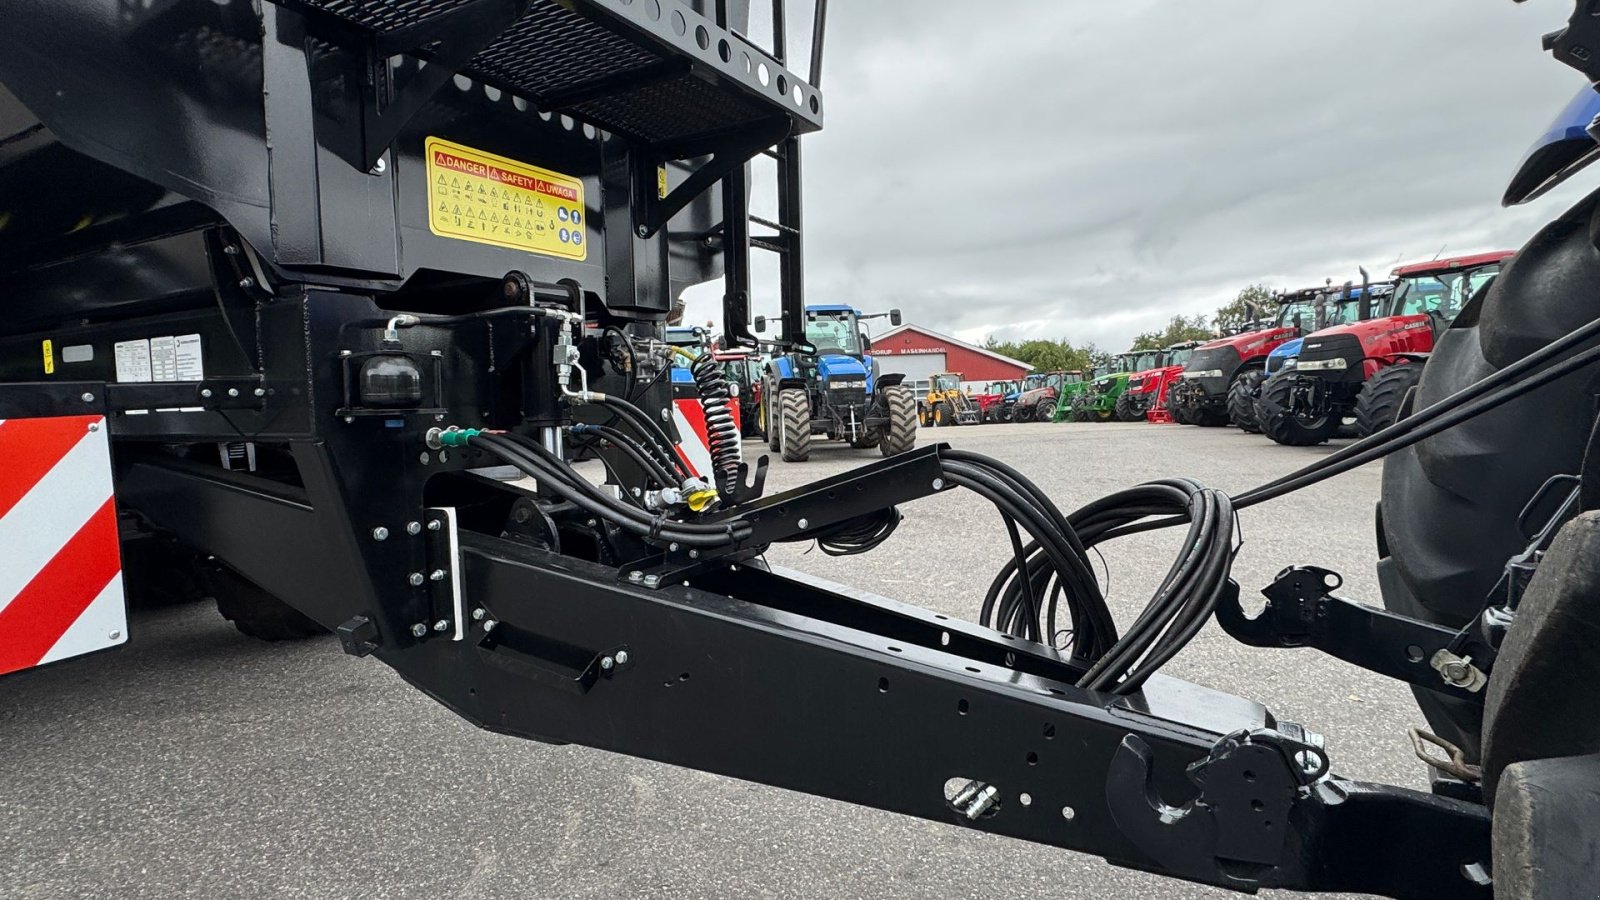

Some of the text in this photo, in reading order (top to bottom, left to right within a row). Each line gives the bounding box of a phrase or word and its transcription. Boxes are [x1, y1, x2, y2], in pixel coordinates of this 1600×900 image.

[446, 156, 486, 175] DANGER
[501, 171, 533, 188] SAFETY
[546, 184, 574, 198] UWAGA
